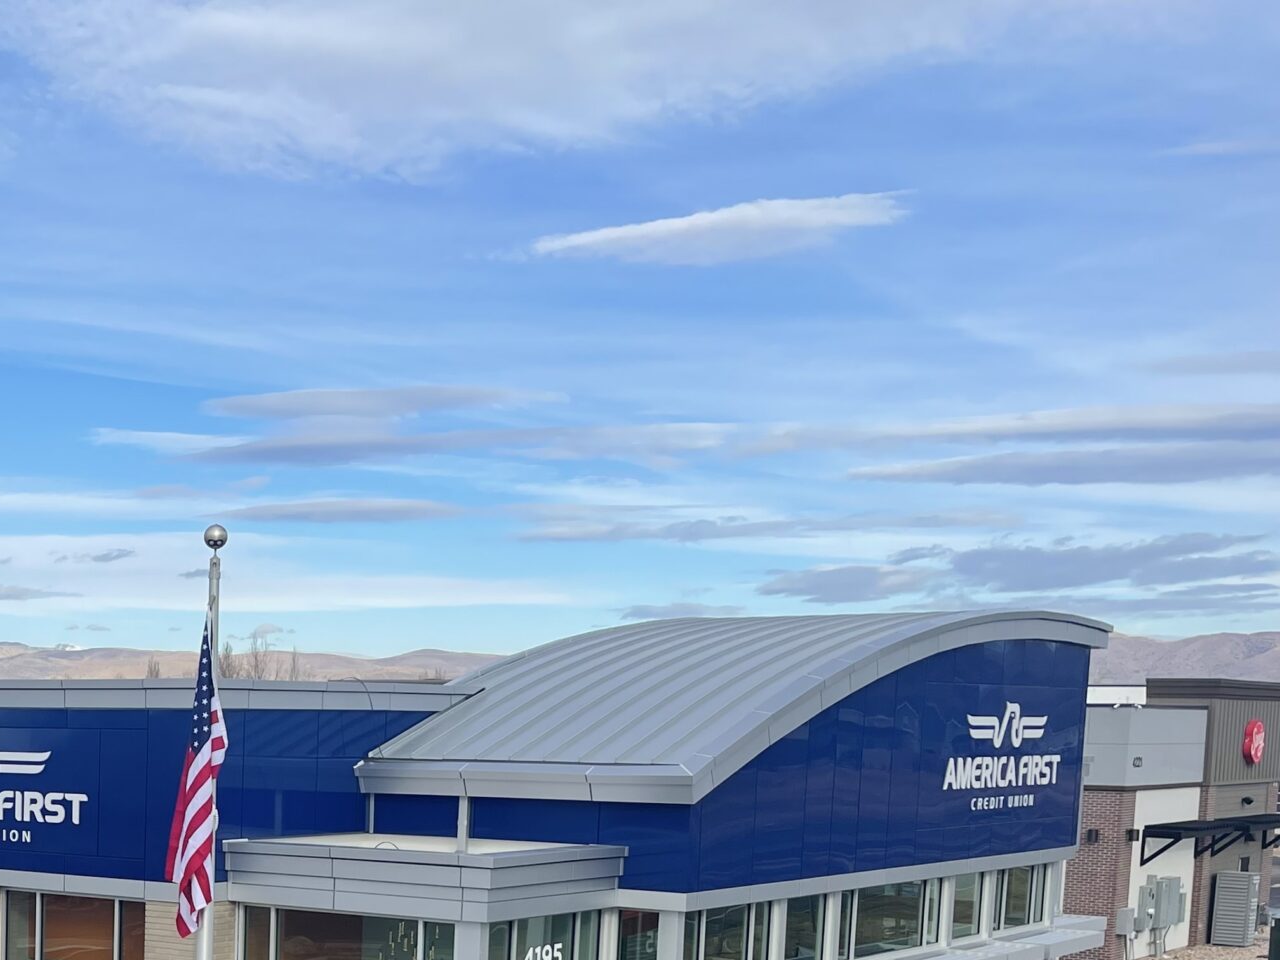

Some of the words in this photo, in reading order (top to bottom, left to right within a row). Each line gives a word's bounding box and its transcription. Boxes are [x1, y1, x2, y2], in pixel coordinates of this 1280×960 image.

[942, 756, 1017, 790] AMERICA
[1018, 755, 1061, 786] FIRST
[970, 796, 1005, 811] CREDIT
[1007, 794, 1035, 808] UNION
